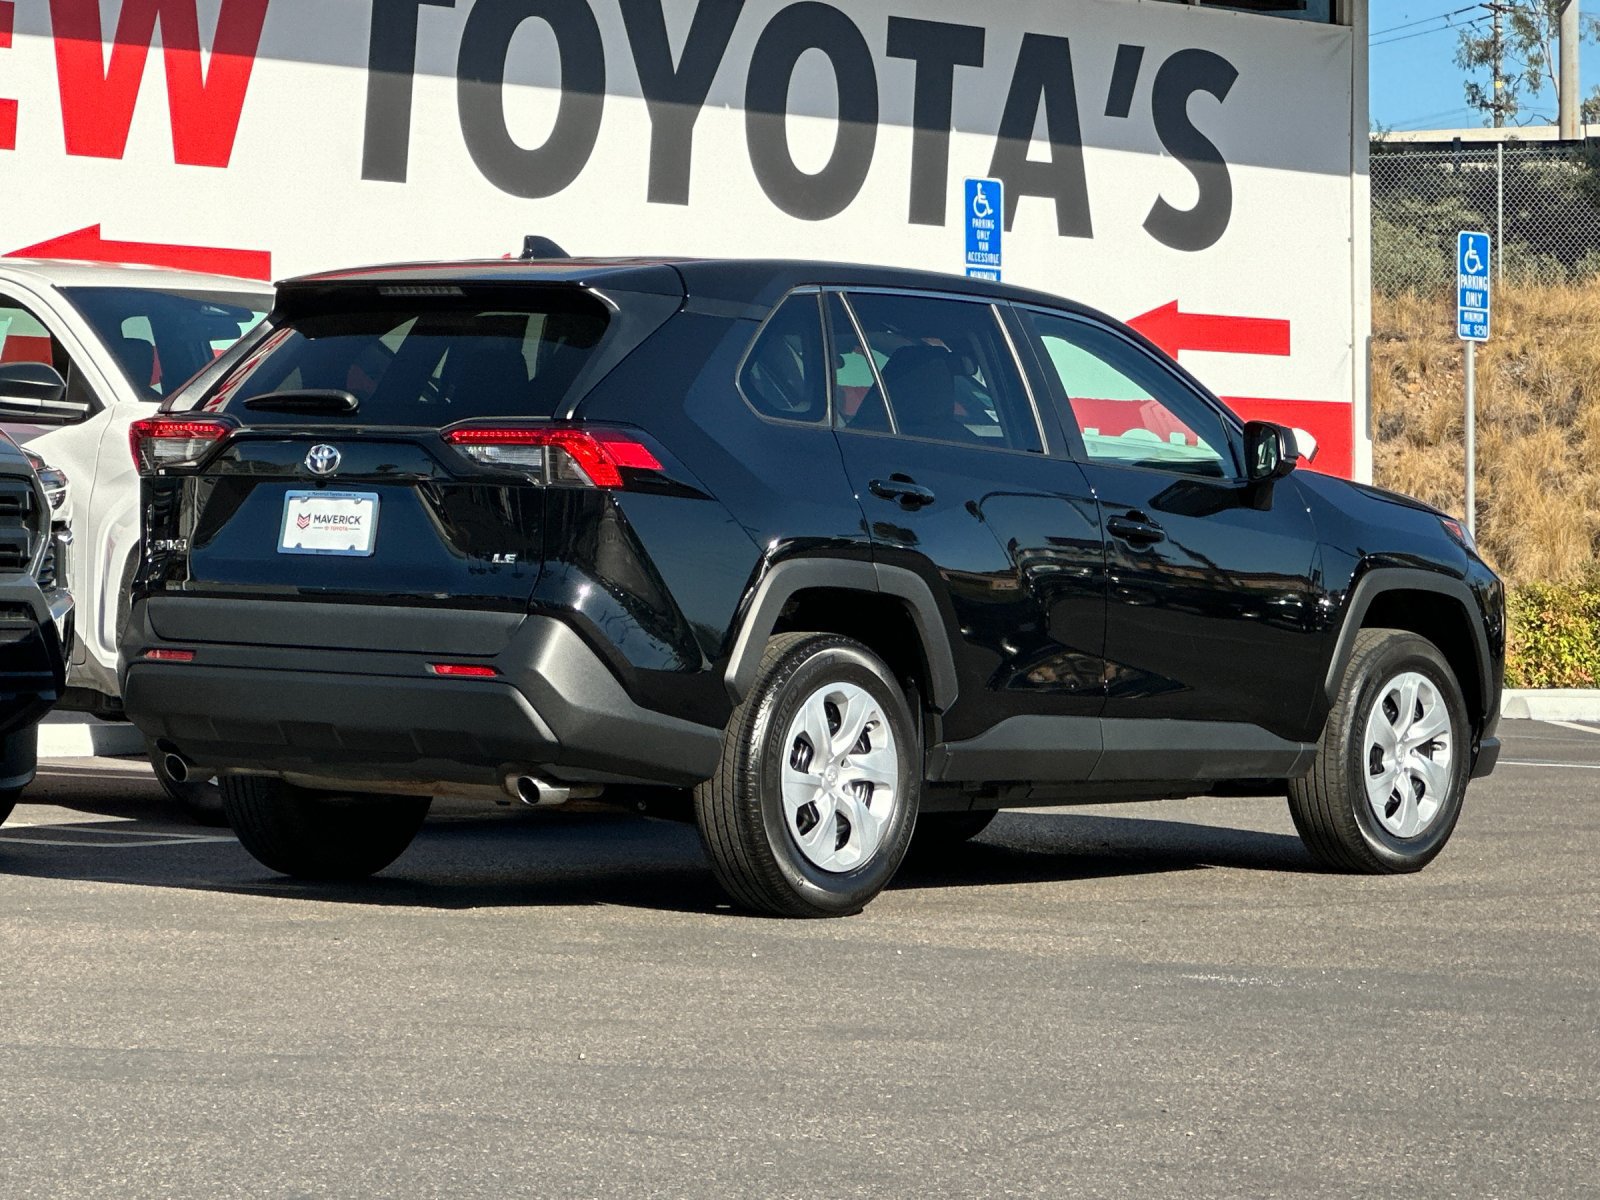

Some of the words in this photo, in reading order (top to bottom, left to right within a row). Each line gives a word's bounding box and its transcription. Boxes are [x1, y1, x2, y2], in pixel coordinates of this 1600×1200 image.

[0, 0, 268, 168] W
[361, 0, 1239, 252] TOYOTA'S
[972, 218, 995, 230] PARKING
[976, 229, 991, 241] ONLY
[978, 241, 989, 252] VAN
[967, 251, 1000, 264] ACCESSIBLE
[1460, 274, 1488, 291] PARKING
[1465, 291, 1483, 307] ONLY
[1460, 323, 1471, 335] FINE
[313, 514, 362, 526] MAVERICK
[492, 553, 517, 564] LE
